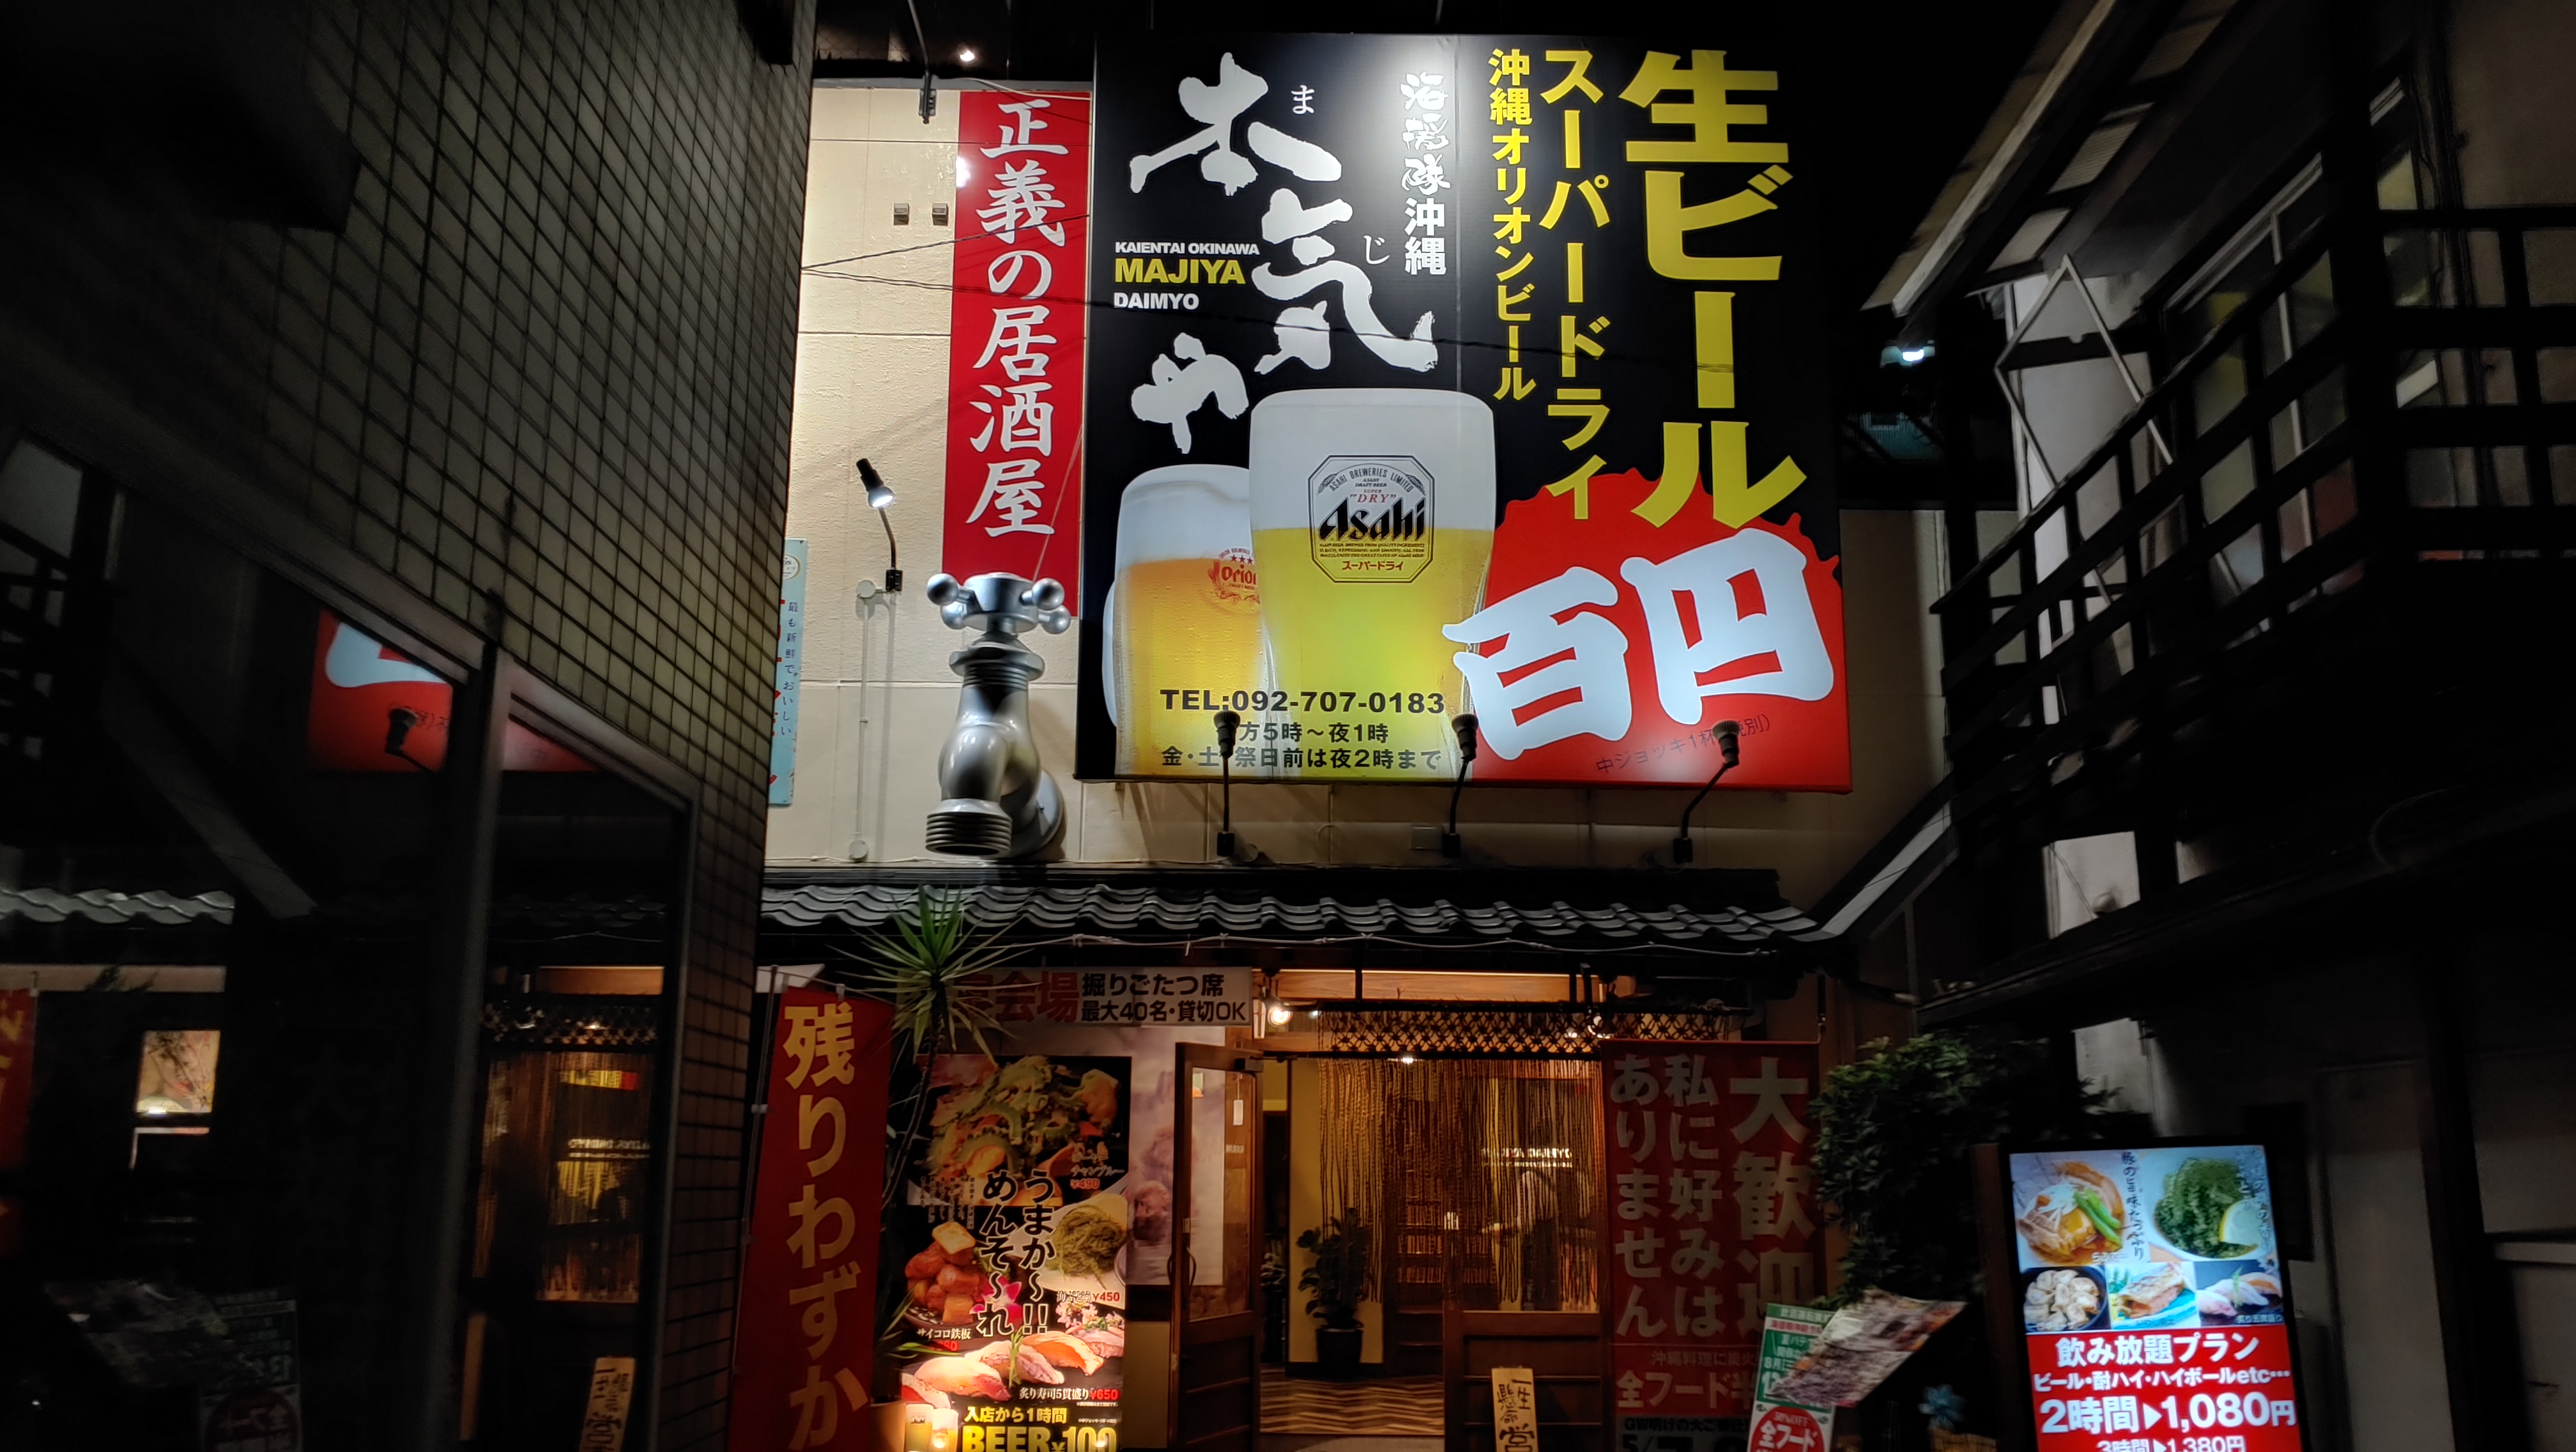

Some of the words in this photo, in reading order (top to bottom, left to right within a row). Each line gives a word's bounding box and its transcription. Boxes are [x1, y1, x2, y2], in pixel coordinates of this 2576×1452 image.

[1291, 84, 1315, 114] ま
[1488, 49, 1537, 401] 沖縄オリオンビール
[1115, 242, 1185, 254] KAIENTAI
[1188, 242, 1260, 255] OKINAWA
[1363, 235, 1390, 265] じ
[1115, 258, 1246, 284] MAJIYA
[1539, 49, 1611, 520] スーパードライ
[1114, 292, 1199, 310] DAIMYO
[1618, 49, 1807, 529] 生ビール
[966, 99, 1069, 537] 正義の居酒屋
[1329, 474, 1348, 492] ASAHI
[1349, 467, 1388, 479] BREWERIES
[1390, 472, 1414, 493] LIMITED
[1318, 497, 1426, 542] Asahi
[1342, 560, 1404, 571] スーパードライ
[1441, 527, 1834, 760] 百円
[1160, 689, 1445, 714] TEL:092-707-0183
[1218, 721, 1389, 744] 方5時～夜1時
[1162, 745, 1442, 769] 金・土祭日前は夜2時まで
[1082, 973, 1225, 997] 掘りごたつ席
[1081, 999, 1247, 1023] 最大40名・貸切OK
[1610, 1052, 1668, 1338] ありません
[1663, 1053, 1724, 1338] 私に好みは
[1729, 1055, 1818, 1338] 大歓迎
[783, 1001, 871, 1452] 残りわずか
[916, 1327, 972, 1340] サイコロ鉄板
[2055, 1331, 2260, 1368] 飲み放題プラン
[1019, 1387, 1089, 1400] 炙り寿司5貫盛り
[1089, 1388, 1119, 1400] ¥650
[963, 1407, 1068, 1425] 入店から1時間
[2040, 1396, 2140, 1434] 2時間
[2161, 1391, 2297, 1433] 1,080円
[962, 1425, 1052, 1452] BEER
[1759, 1419, 1819, 1449] 全フード
